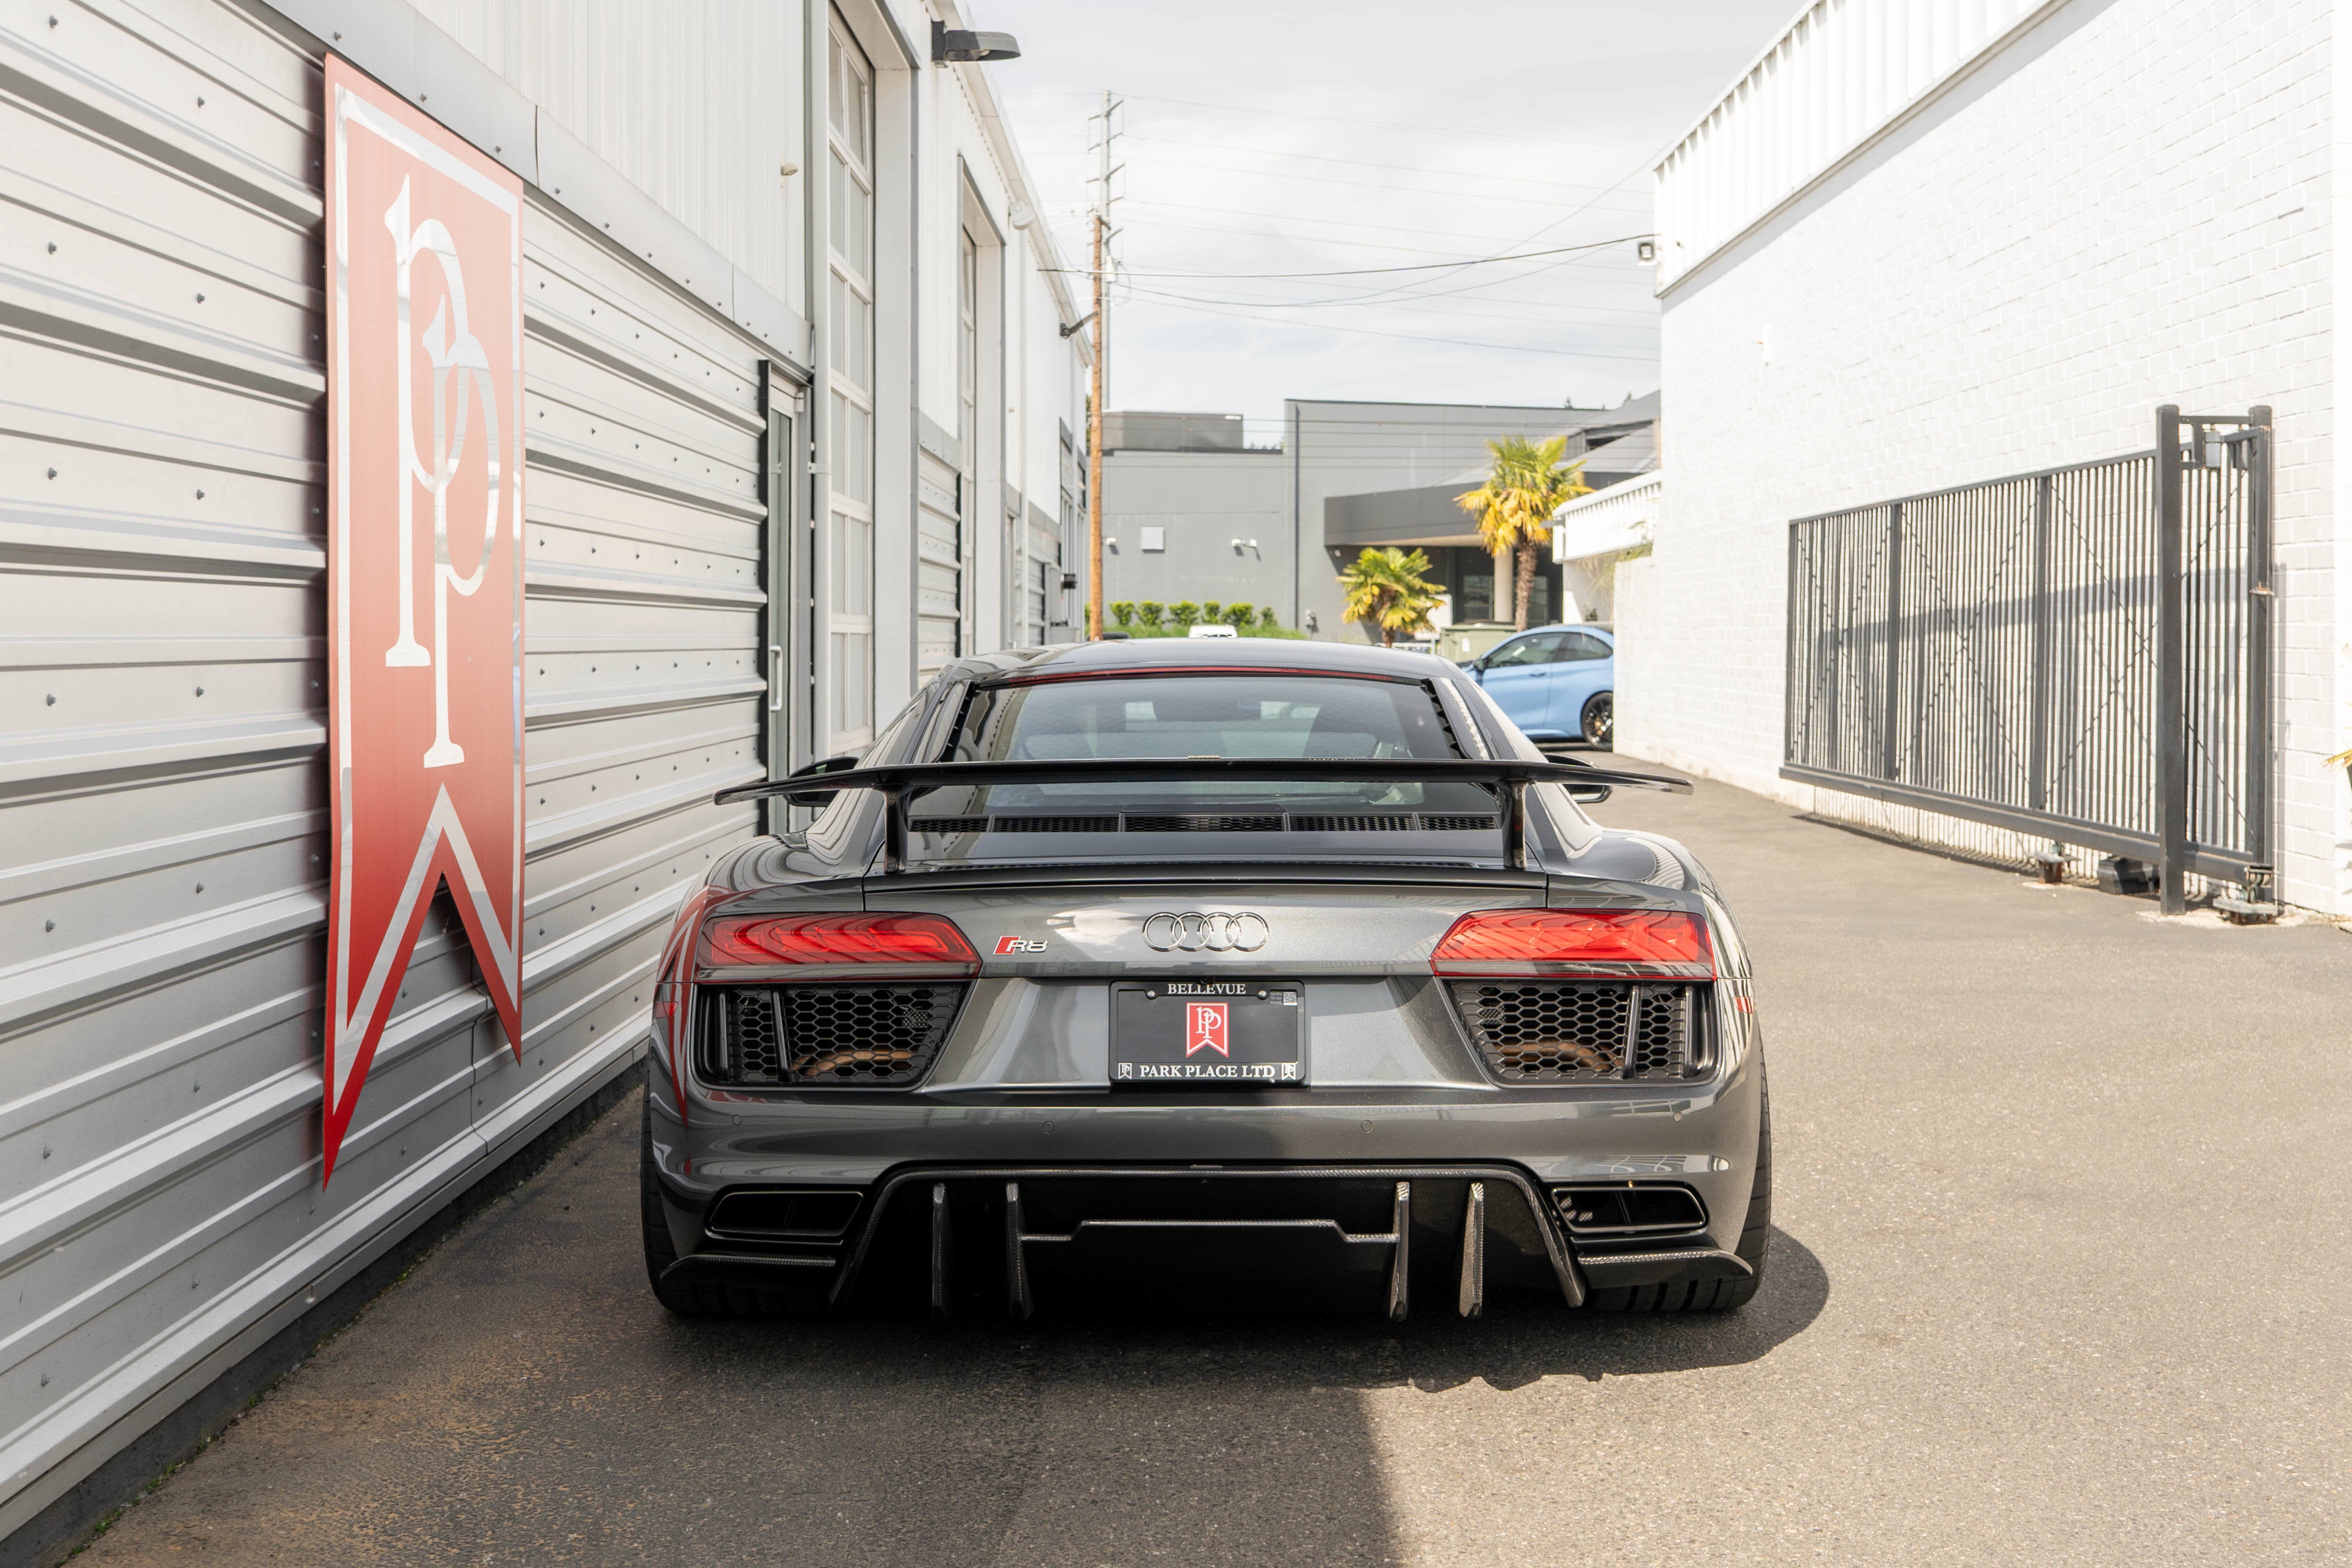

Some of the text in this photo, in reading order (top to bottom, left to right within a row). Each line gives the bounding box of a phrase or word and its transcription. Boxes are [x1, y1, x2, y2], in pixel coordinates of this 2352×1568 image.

[1006, 940, 1048, 952] R8
[1167, 983, 1246, 994] BELLEVUE
[1139, 1065, 1276, 1077] PARK PLACE LTD
